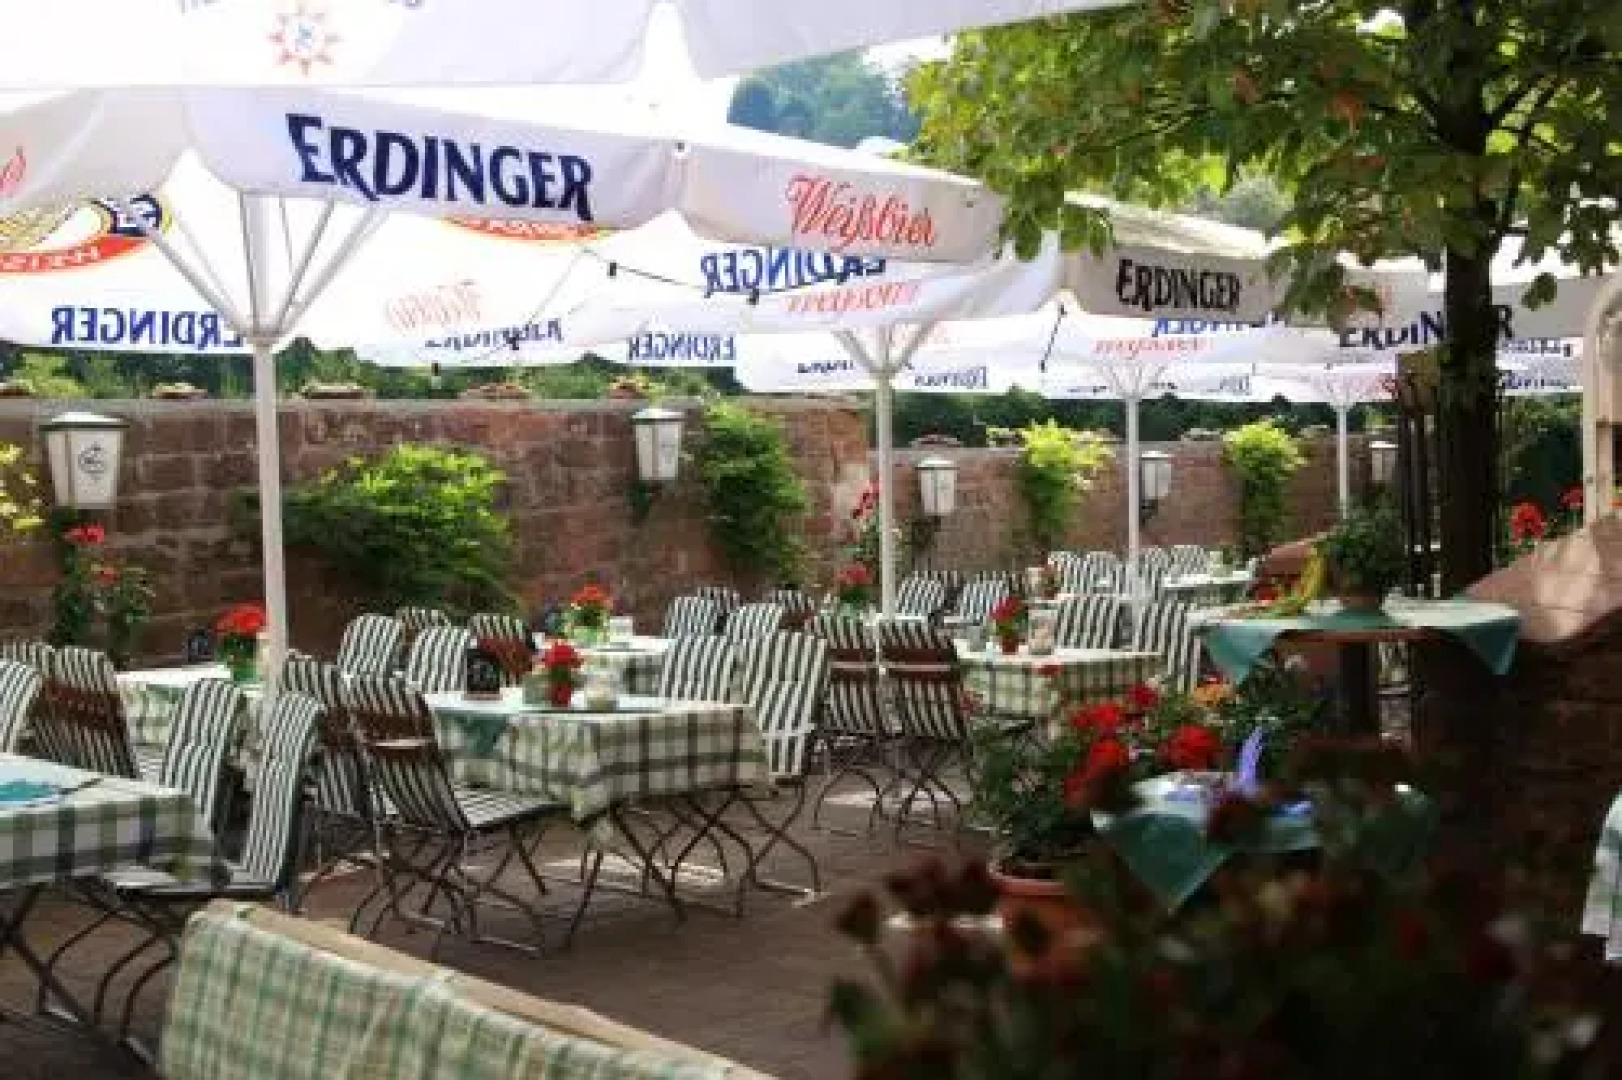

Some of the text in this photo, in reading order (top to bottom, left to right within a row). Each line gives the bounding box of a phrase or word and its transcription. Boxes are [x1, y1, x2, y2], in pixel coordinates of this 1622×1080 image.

[286, 113, 593, 221] ERDINGER
[785, 174, 936, 250] Weißbier
[1115, 258, 1241, 311] ERDINGER
